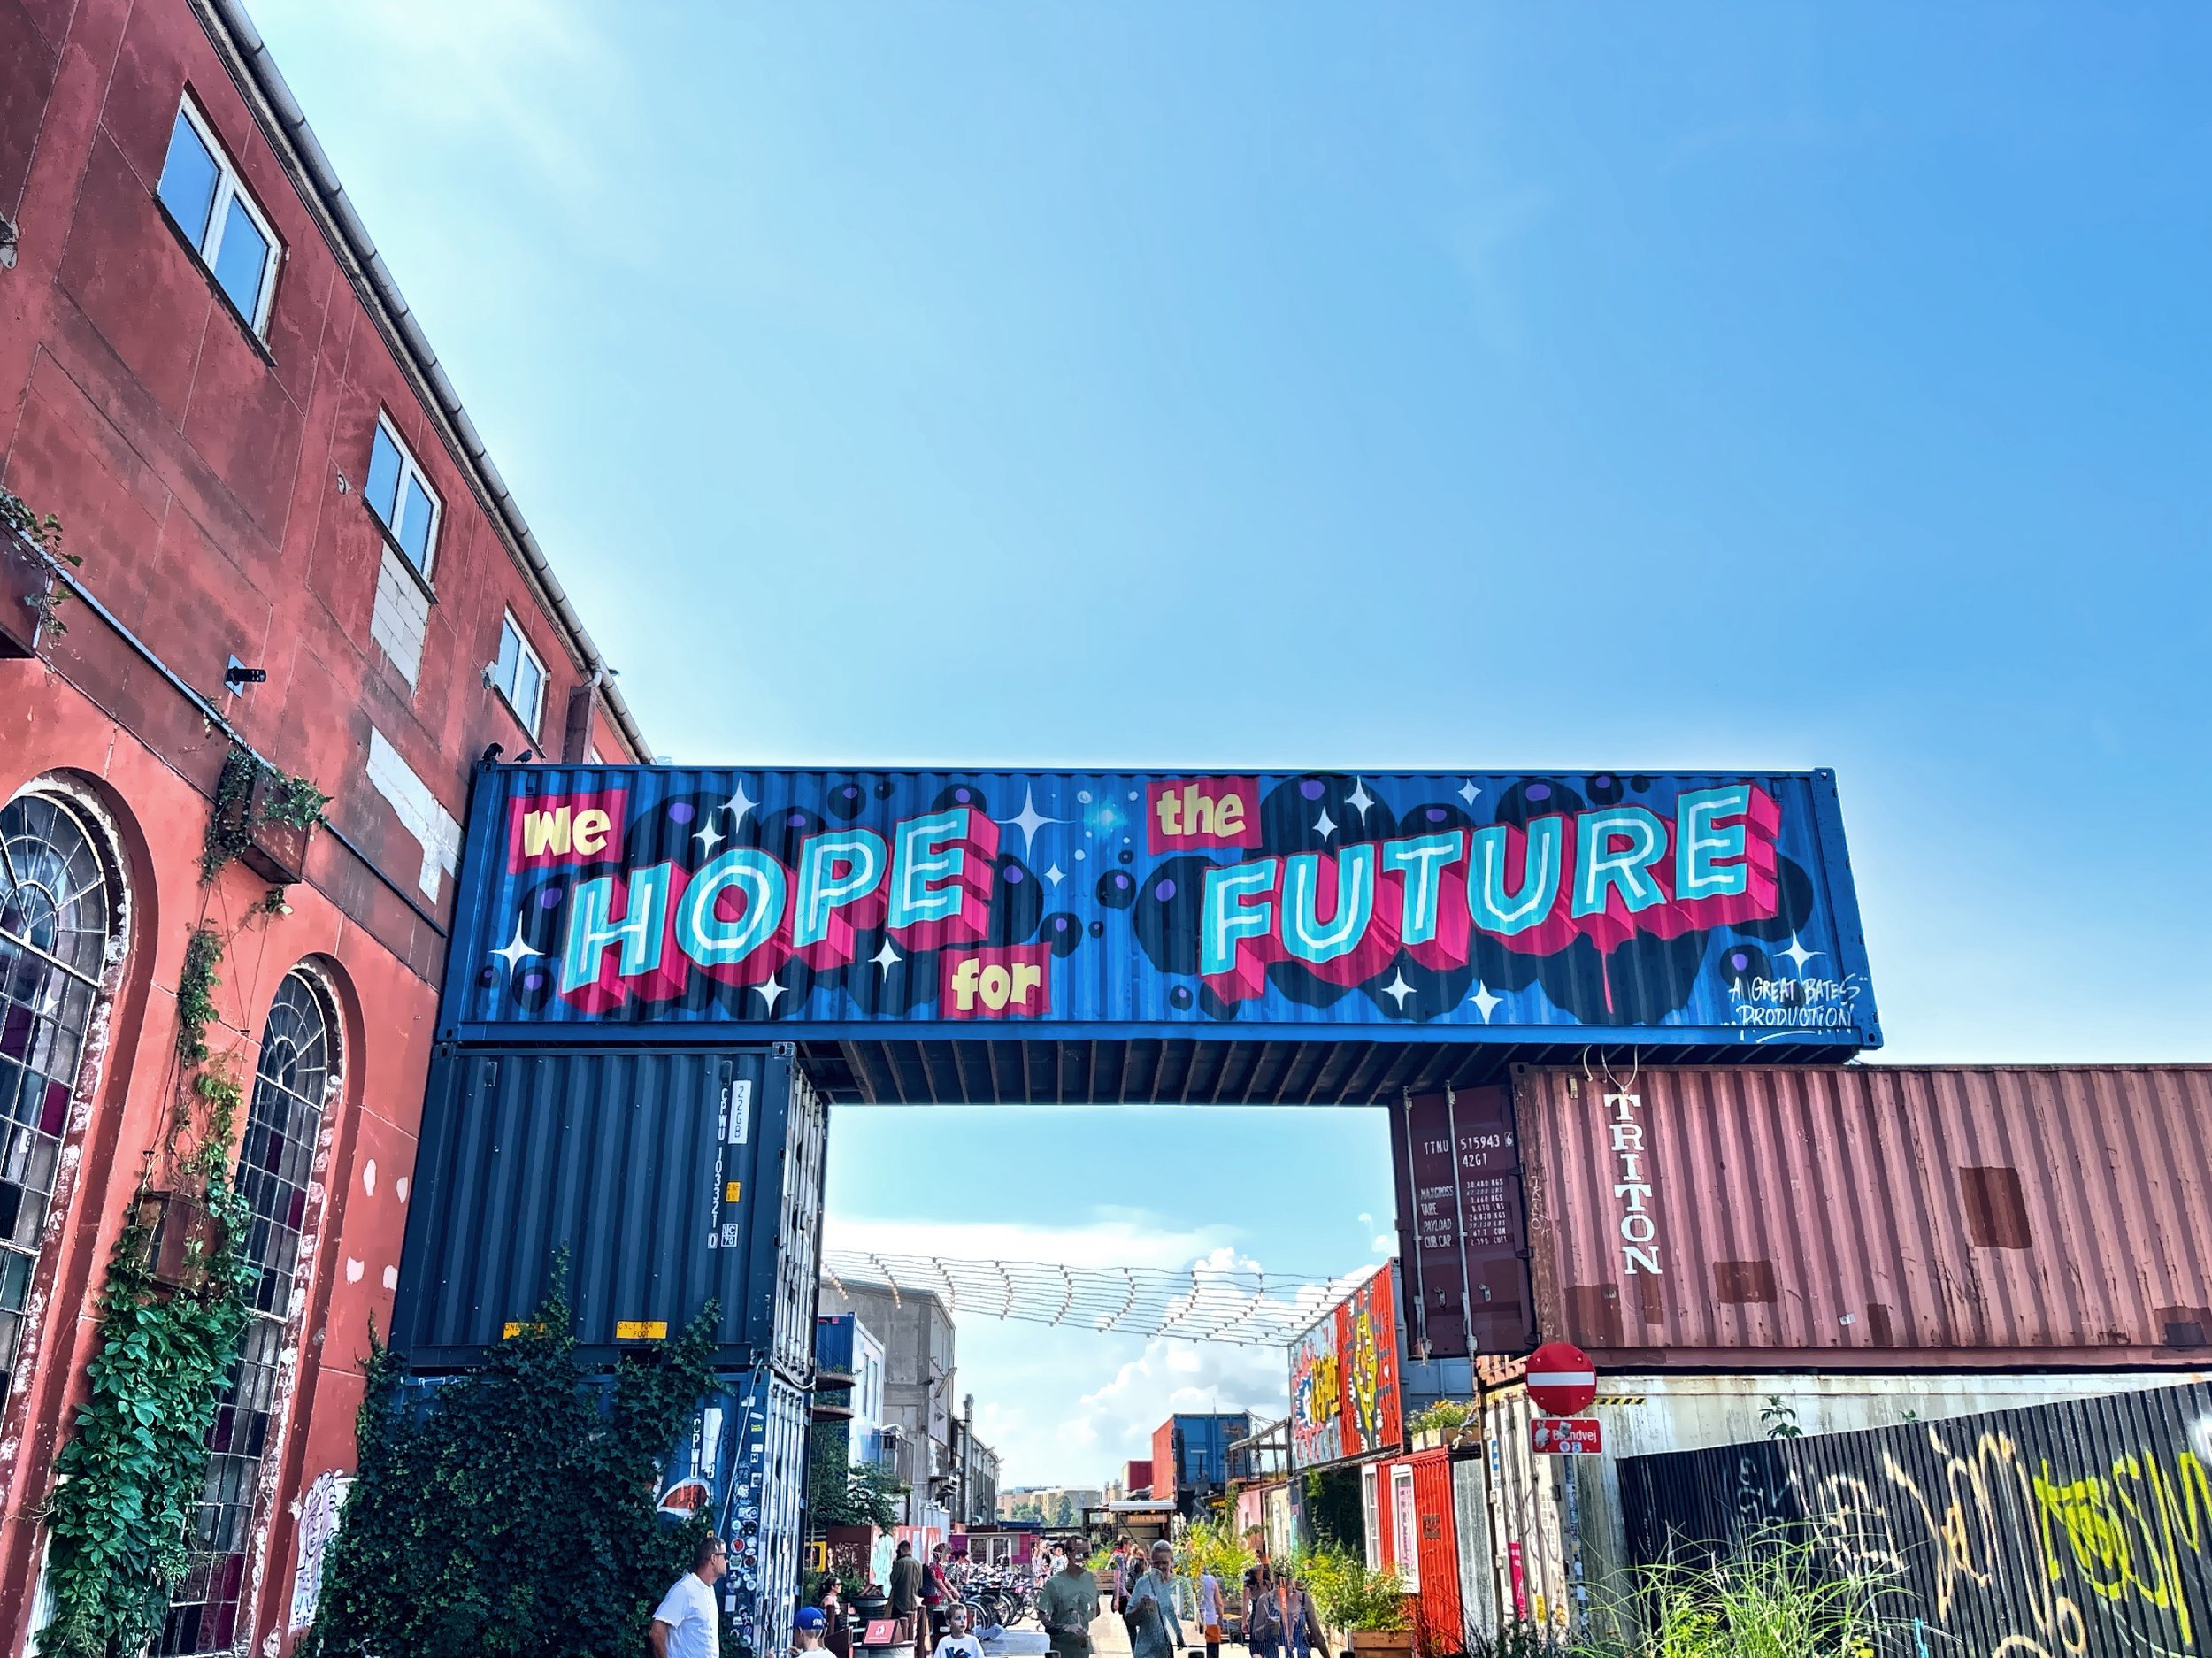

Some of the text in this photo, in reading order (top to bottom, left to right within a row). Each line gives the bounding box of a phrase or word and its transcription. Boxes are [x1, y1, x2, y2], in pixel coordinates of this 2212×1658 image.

[1156, 787, 1245, 837] the
[559, 806, 997, 1010] HOPE
[1201, 783, 1778, 1000] FUTURE
[951, 957, 1042, 1011] for
[1728, 976, 1741, 1003] A
[1751, 976, 1797, 1003] GREAT
[718, 1087, 728, 1141] CPWU
[735, 1086, 744, 1138] 22GB
[1424, 1140, 1448, 1155] TTNU
[1460, 1134, 1501, 1151] 515943
[1462, 1153, 1487, 1168] 42G1
[1603, 1094, 1663, 1275] TRITON
[1424, 1218, 1452, 1232] PAYLOAD
[1552, 1430, 1597, 1444] Bndvej
